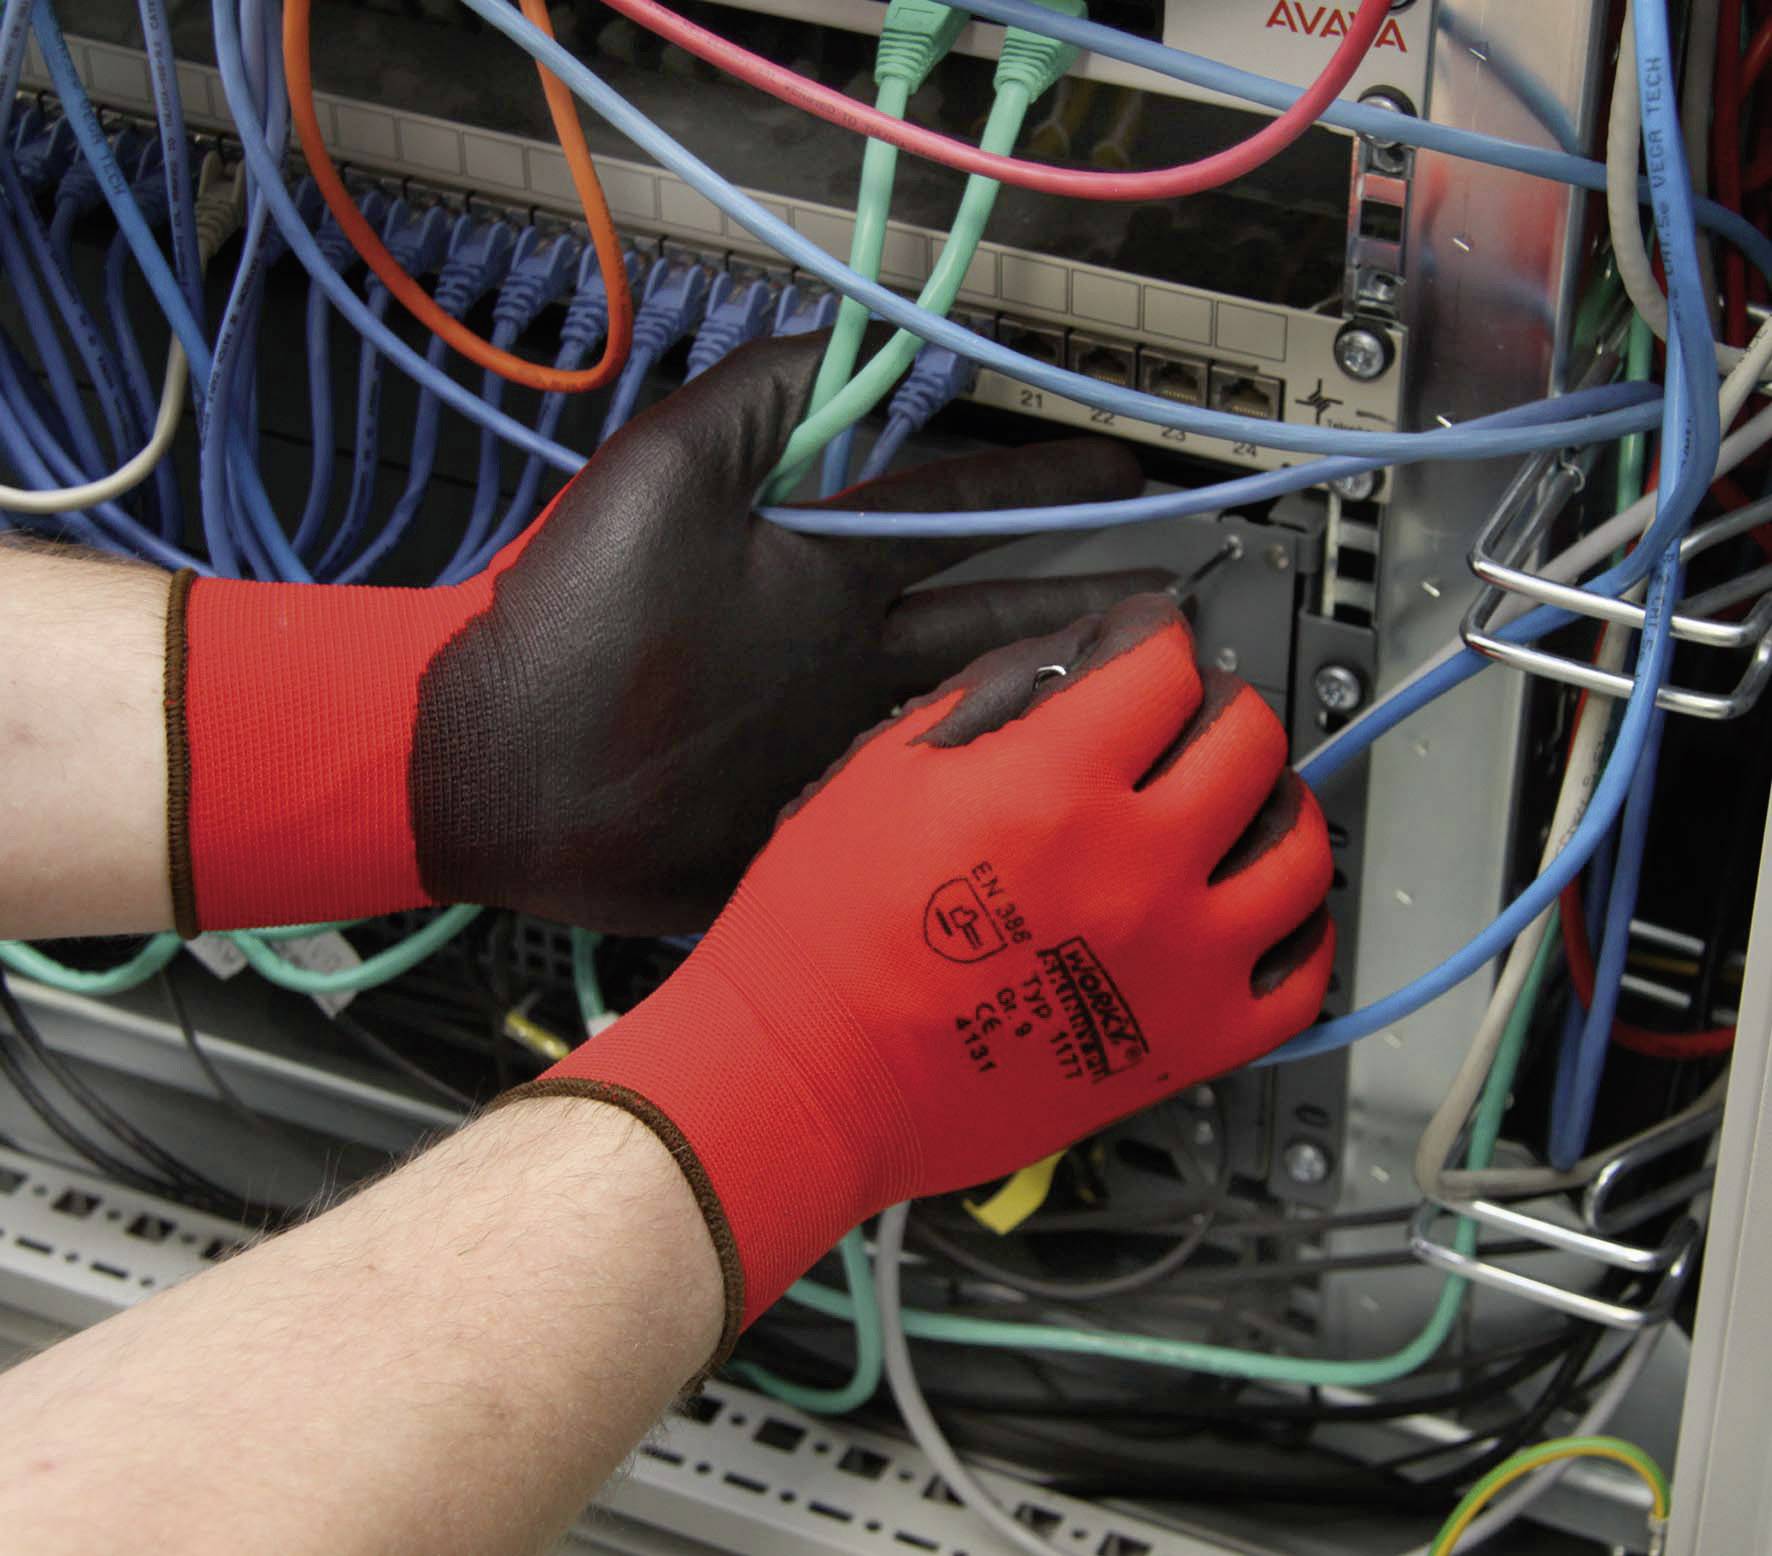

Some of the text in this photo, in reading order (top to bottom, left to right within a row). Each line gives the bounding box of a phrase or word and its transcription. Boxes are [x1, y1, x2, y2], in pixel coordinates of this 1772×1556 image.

[1265, 0, 1408, 53] AVAA
[1646, 56, 1662, 117] TECH
[1651, 129, 1667, 189] VEGA
[1020, 388, 1043, 409] 21
[1089, 406, 1115, 427] 22
[1232, 441, 1258, 459] 24
[972, 861, 1004, 899] EN
[955, 1017, 997, 1073] 4131
[1050, 1031, 1084, 1081] 1177
